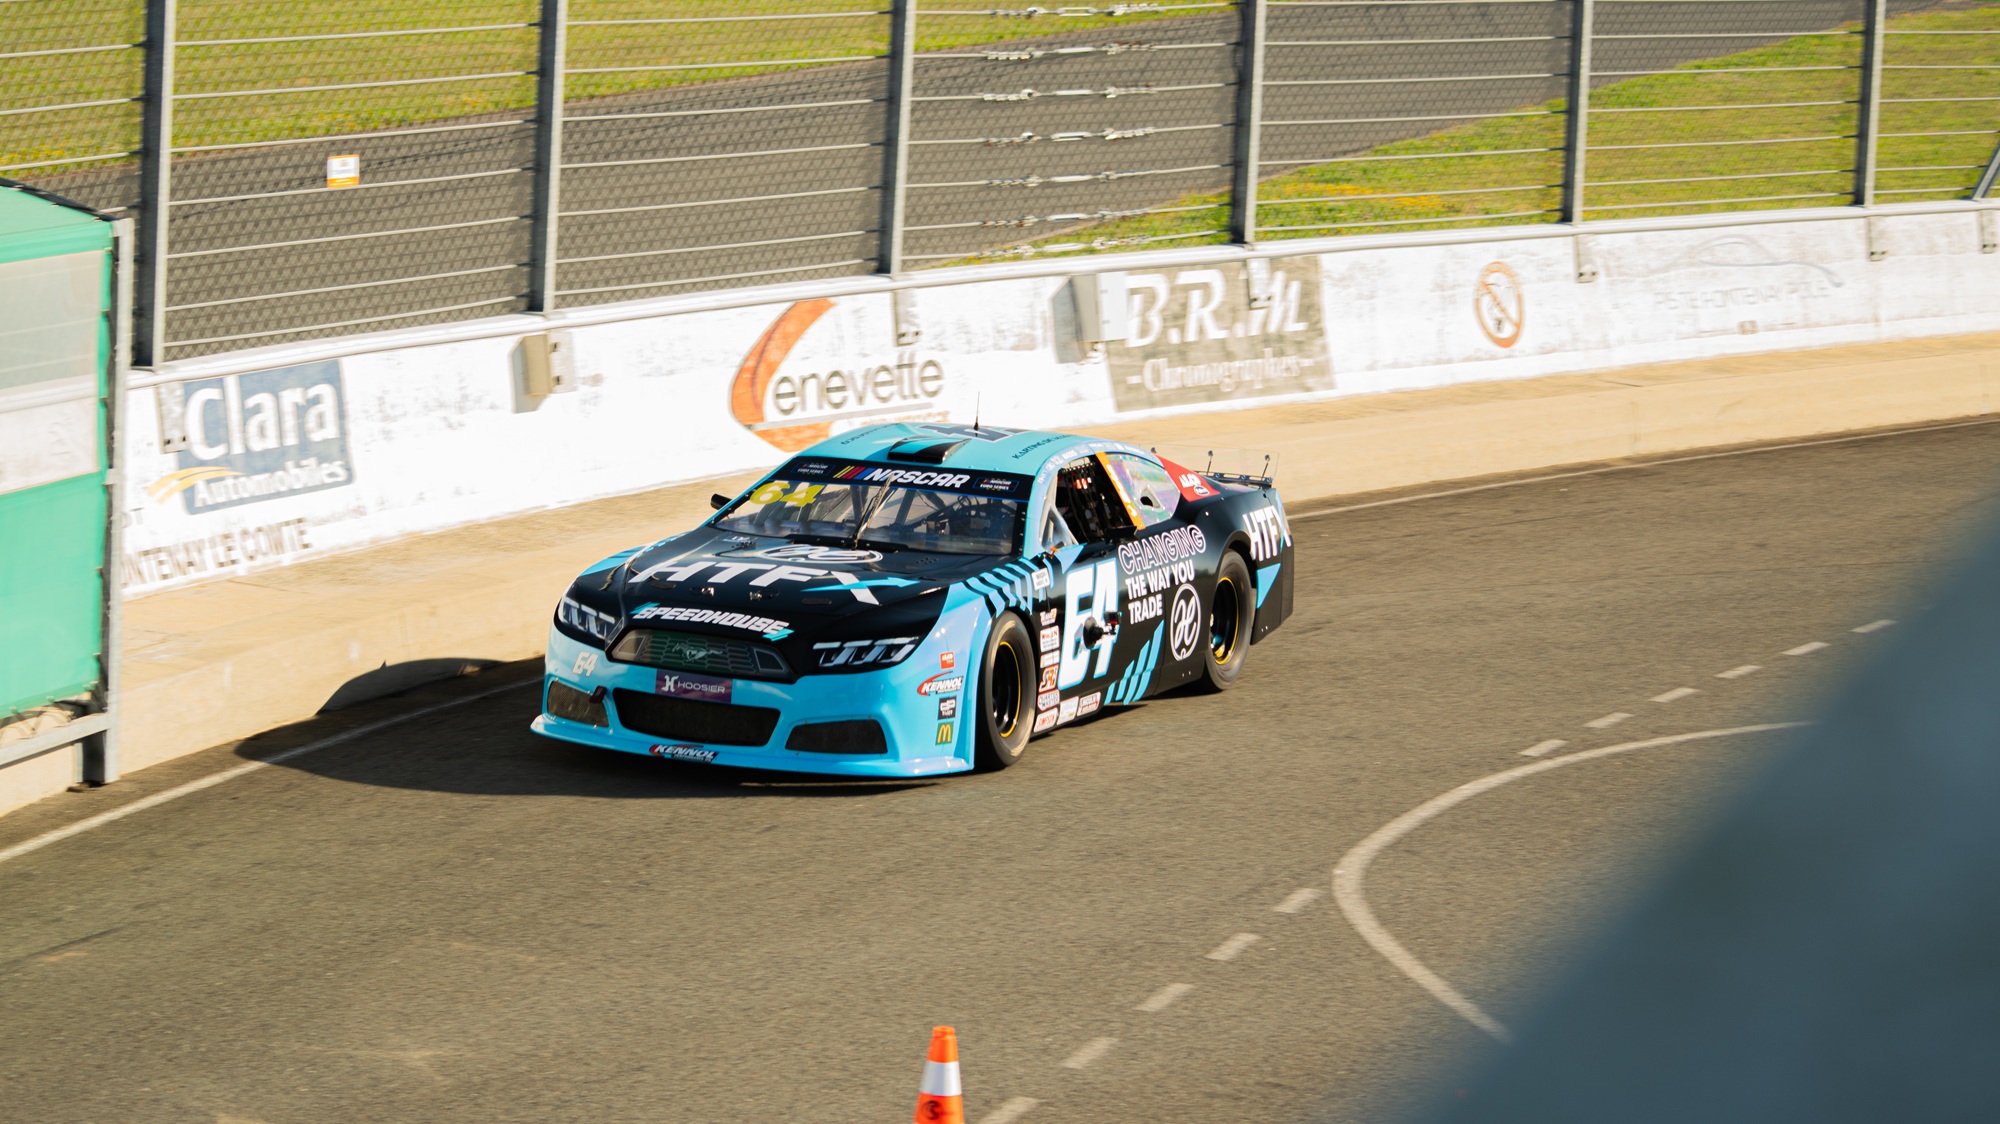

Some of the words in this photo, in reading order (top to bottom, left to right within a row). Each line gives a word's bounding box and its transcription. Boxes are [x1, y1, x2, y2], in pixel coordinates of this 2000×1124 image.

[183, 375, 341, 461] Clara
[194, 457, 349, 508] Automobiles
[749, 481, 825, 508] 64
[864, 468, 971, 489] NASCAR
[1242, 505, 1293, 562] HTFX
[1118, 524, 1207, 576] CHANGING
[628, 561, 880, 605] HTFX
[1124, 571, 1148, 601] THE
[1147, 566, 1172, 594] WAY
[1171, 559, 1196, 588] YOU
[633, 605, 790, 634] SPEEDHOUSE
[1057, 557, 1119, 691] 64
[1128, 593, 1163, 625] TRADE
[571, 651, 600, 678] 64
[677, 681, 726, 695] HOOSIER
[921, 676, 963, 694] KENNOL
[654, 744, 716, 759] KENNOL
